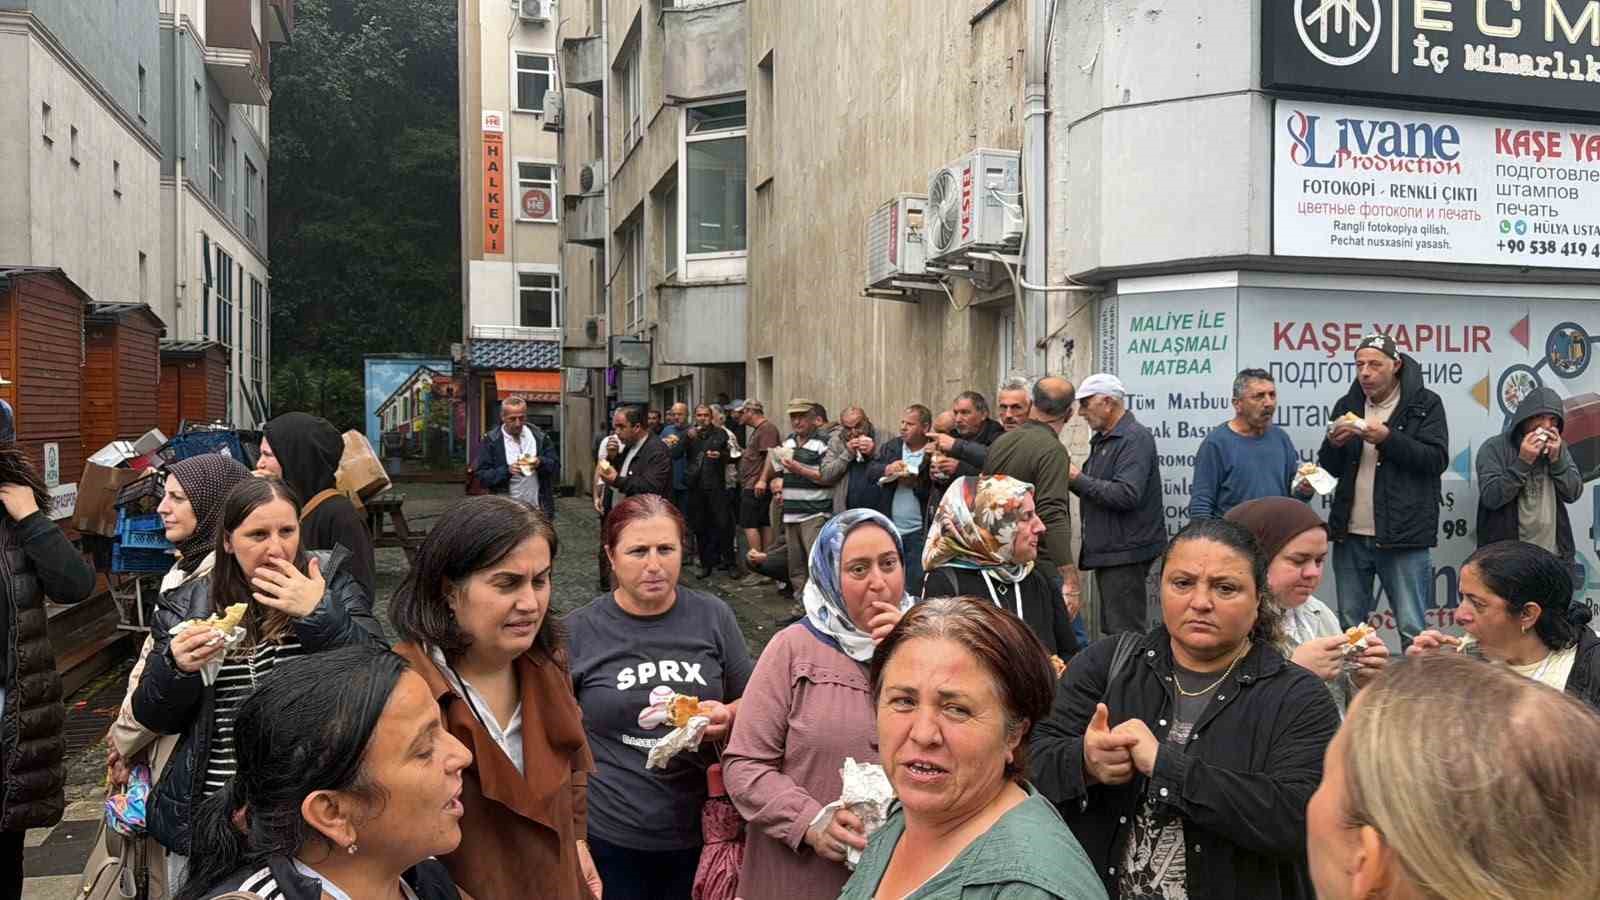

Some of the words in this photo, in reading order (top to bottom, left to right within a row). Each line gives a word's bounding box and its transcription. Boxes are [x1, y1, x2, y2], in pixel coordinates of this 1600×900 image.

[1414, 0, 1600, 47] ECM
[1464, 43, 1600, 83] Mimarlık
[1302, 115, 1460, 168] Livane
[1495, 128, 1562, 162] KAŞE
[1336, 148, 1461, 174] Production
[1496, 164, 1600, 182] подготовле
[962, 160, 972, 239] VESTEL
[1303, 179, 1375, 197] FOTOKOPİ
[1390, 182, 1437, 200] RENKLİ
[1442, 186, 1478, 205] ÇIKTI
[1496, 183, 1579, 200] штампов
[1298, 202, 1356, 216] цветные
[1439, 208, 1482, 222] печать
[1496, 202, 1559, 218] печать
[1333, 221, 1365, 234] Rangli
[1368, 221, 1418, 236] fotokopiya
[1421, 224, 1449, 236] qilish.
[1534, 221, 1569, 235] HÜLYA
[1331, 234, 1365, 246] Pechat
[1367, 236, 1413, 249] nusxasini
[1416, 238, 1452, 251] yasash.
[1497, 240, 1525, 253] +90
[1530, 241, 1557, 255] 538
[1561, 242, 1587, 256] 419
[1129, 312, 1194, 332] MALİYE
[1197, 310, 1226, 329] İLE
[1128, 335, 1227, 356] ANLAŞMALI
[1273, 322, 1362, 358] KAŞE
[1141, 359, 1212, 376] MATBAA
[1443, 519, 1468, 540] 98
[616, 660, 708, 690] SPRX
